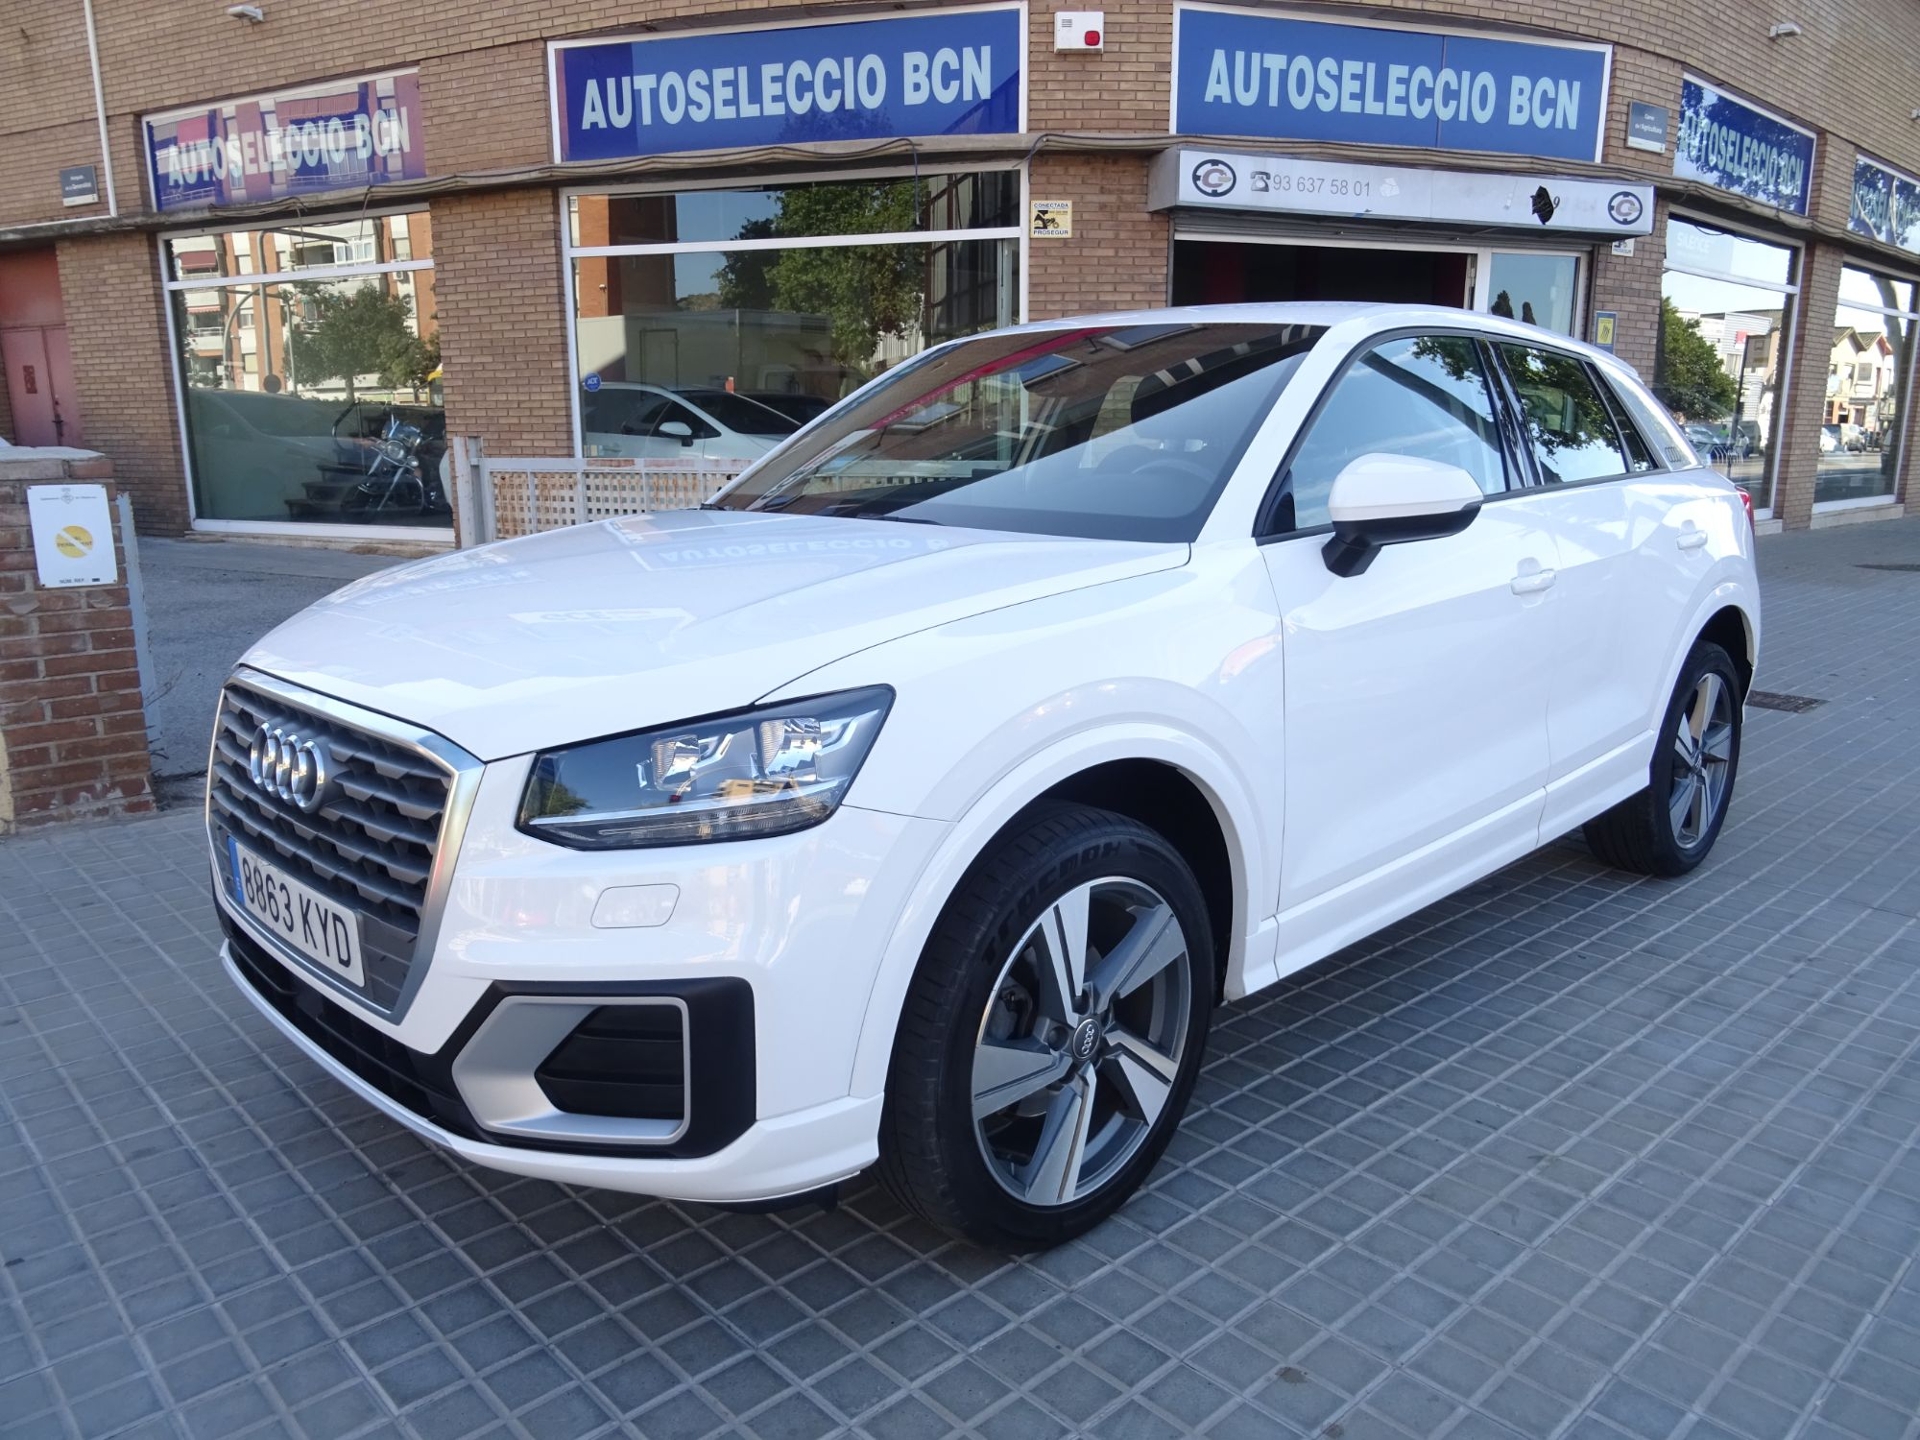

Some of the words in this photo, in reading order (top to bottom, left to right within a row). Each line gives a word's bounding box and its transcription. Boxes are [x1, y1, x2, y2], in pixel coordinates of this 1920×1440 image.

[582, 54, 887, 130] AUTOSELECCIO
[903, 45, 992, 106] BCN
[1204, 49, 1497, 125] AUTOSELECCIO
[1508, 75, 1581, 130] BCN
[168, 116, 347, 186] AUTOSELECCIO
[354, 106, 411, 159] BCN
[1273, 174, 1291, 191] 93
[1297, 176, 1325, 193] 637
[1330, 179, 1348, 195] 58
[1353, 180, 1370, 197] 01
[1780, 154, 1805, 199] BCN
[242, 857, 295, 933] 8863
[299, 893, 352, 969] KYD
